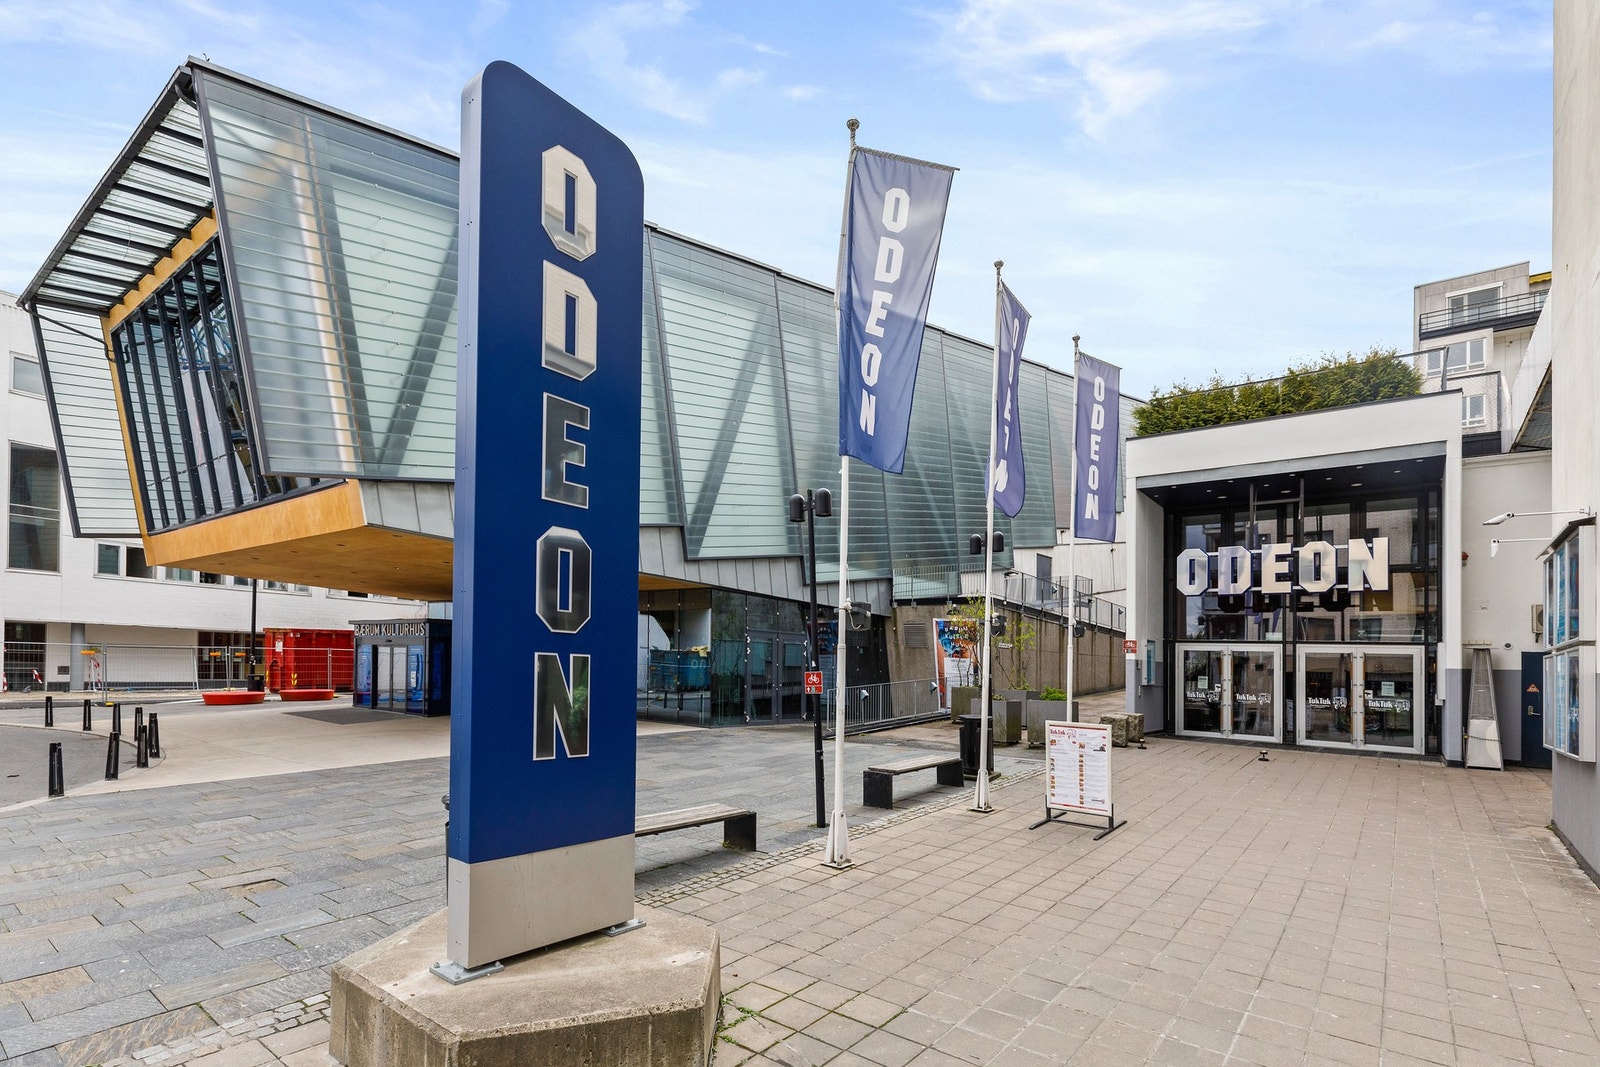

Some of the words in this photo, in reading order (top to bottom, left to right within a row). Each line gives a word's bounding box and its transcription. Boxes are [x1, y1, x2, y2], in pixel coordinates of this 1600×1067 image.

[859, 186, 911, 437] ODEON
[533, 144, 599, 761] ODEON
[1084, 374, 1106, 522] ODEON
[354, 624, 380, 636] BÆRUM
[381, 622, 426, 636] KULTURHUS
[1176, 536, 1390, 597] ODEON
